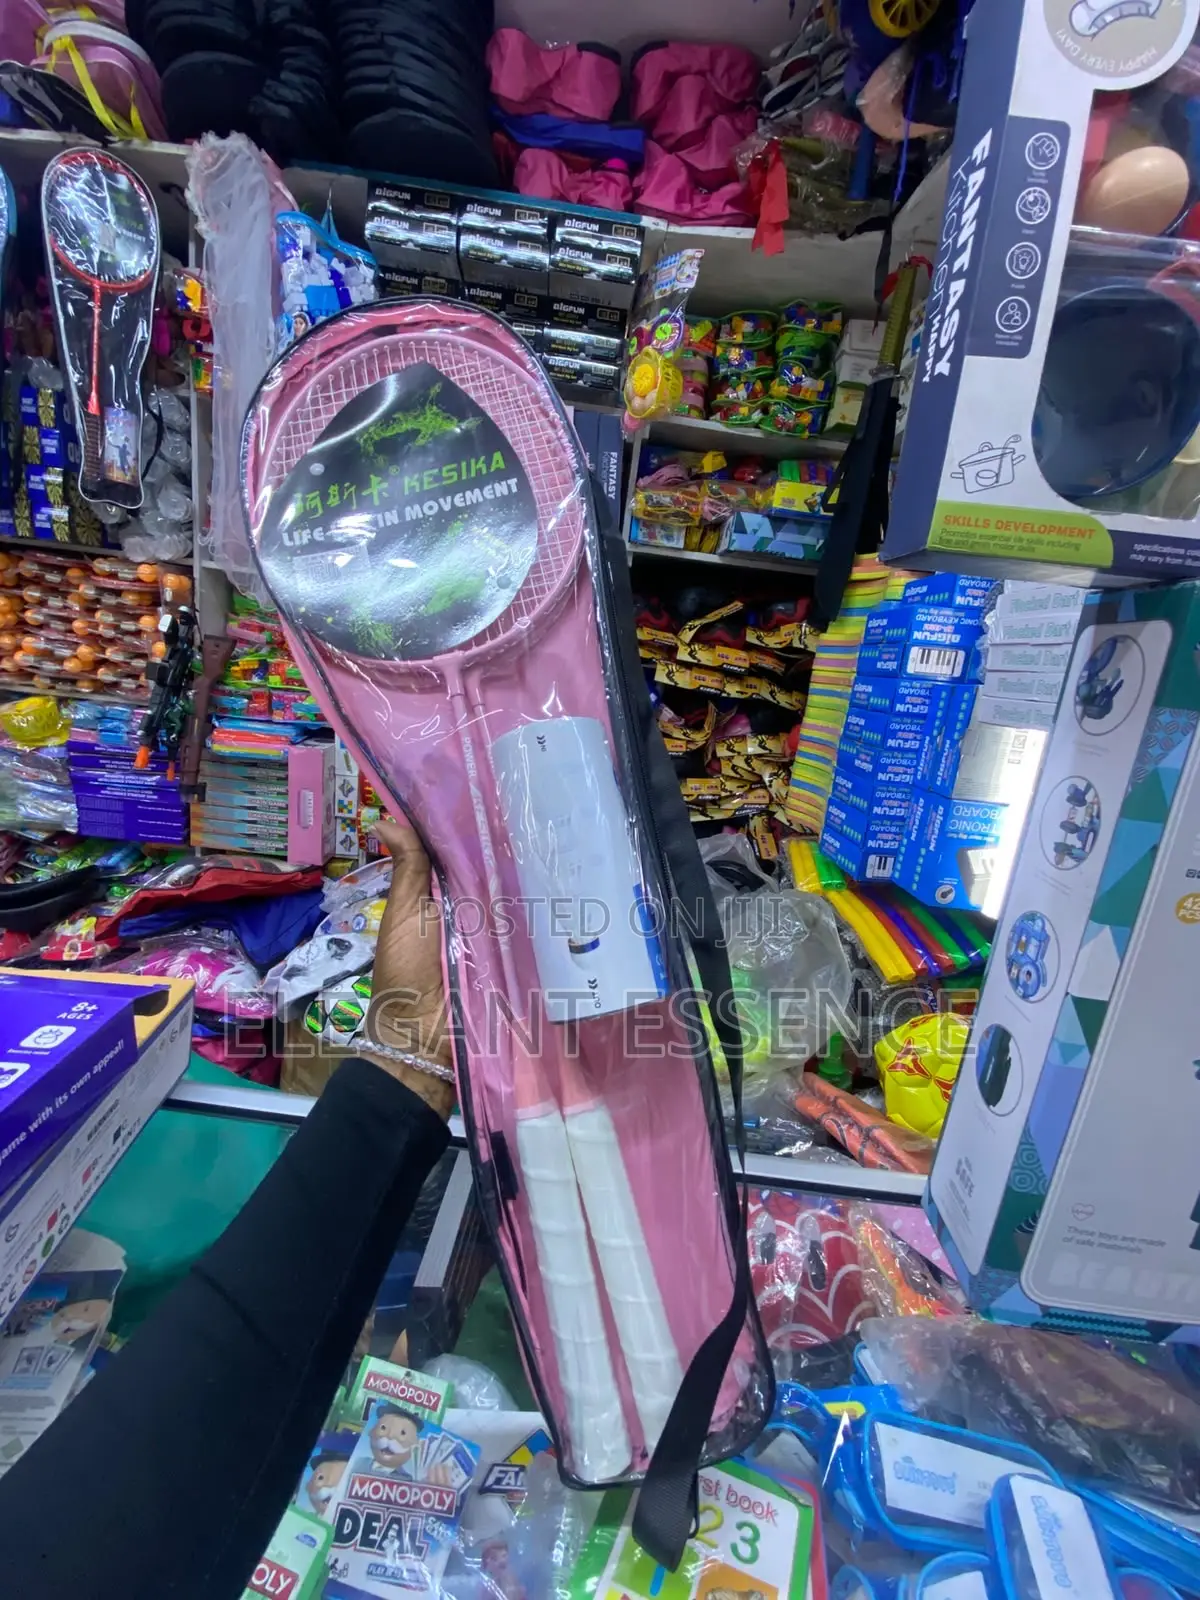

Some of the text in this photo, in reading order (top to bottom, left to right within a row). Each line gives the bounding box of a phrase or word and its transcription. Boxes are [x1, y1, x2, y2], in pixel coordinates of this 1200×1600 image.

[1080, 51, 1115, 73] EVERY
[1118, 46, 1157, 72] HAPPY
[934, 128, 992, 376] FANTASY
[403, 450, 506, 495] KESIKA
[608, 451, 618, 500] FANTASY
[281, 477, 519, 547] LIFE IN MOVEMENT
[943, 514, 1097, 541] SKILLS DEVELOPMENT
[1129, 553, 1146, 563] may
[916, 613, 958, 625] KEYBOARD
[461, 736, 477, 779] POWER
[57, 1012, 93, 1021] AGES
[71, 1001, 98, 1012] 8+
[28, 1107, 53, 1133] with
[55, 1093, 69, 1109] its
[70, 1072, 91, 1095] own
[92, 1039, 125, 1075] appeal!
[1061, 1235, 1076, 1243] of
[1076, 1238, 1095, 1247] safe
[1066, 1225, 1096, 1237] These
[1098, 1232, 1119, 1241] toys
[367, 1377, 439, 1408] MONOPOLY
[350, 1480, 456, 1511] MONOPOLY
[725, 1483, 779, 1527] book
[332, 1503, 430, 1562] DEAL
[730, 1521, 761, 1565] 3
